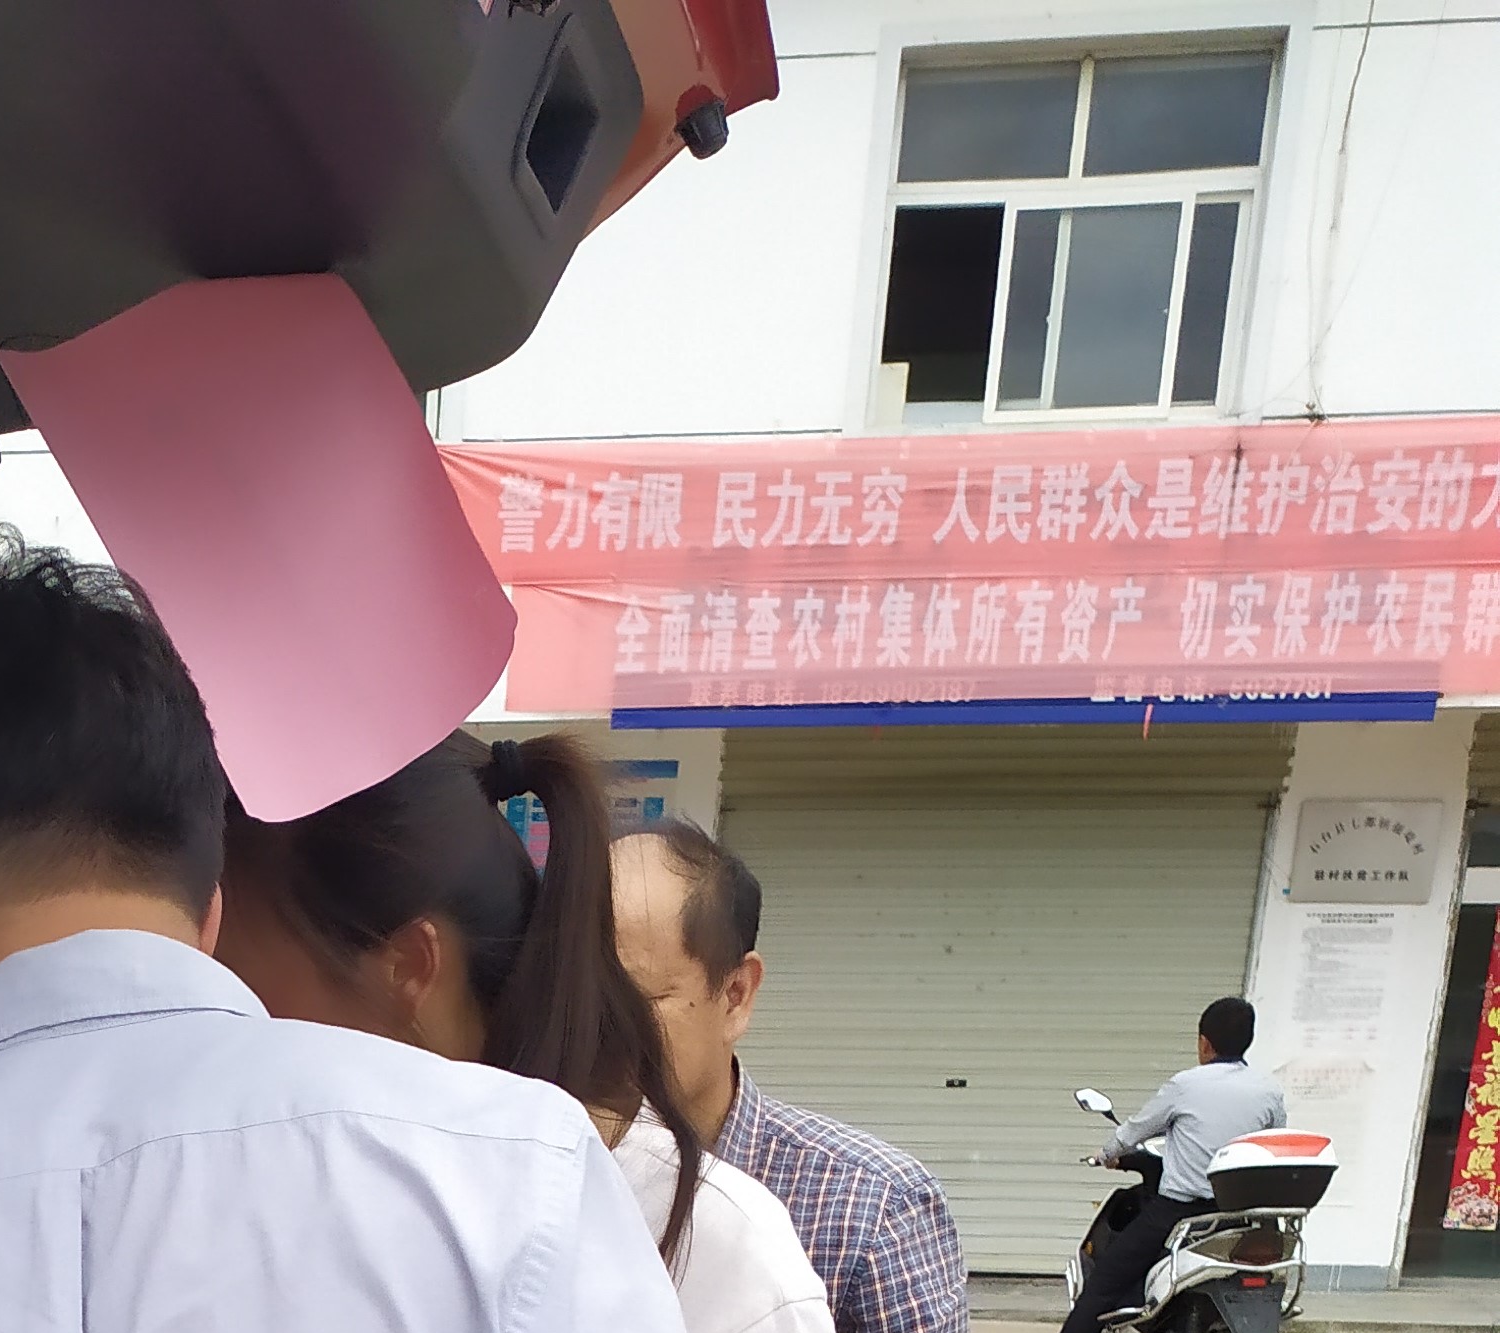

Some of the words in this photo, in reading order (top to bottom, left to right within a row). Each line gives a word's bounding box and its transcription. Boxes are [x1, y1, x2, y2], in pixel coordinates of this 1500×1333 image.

[498, 472, 684, 554] 警力有限
[712, 466, 908, 550] 民力无穷
[613, 577, 1147, 674] 全面清查农村集体所有资产
